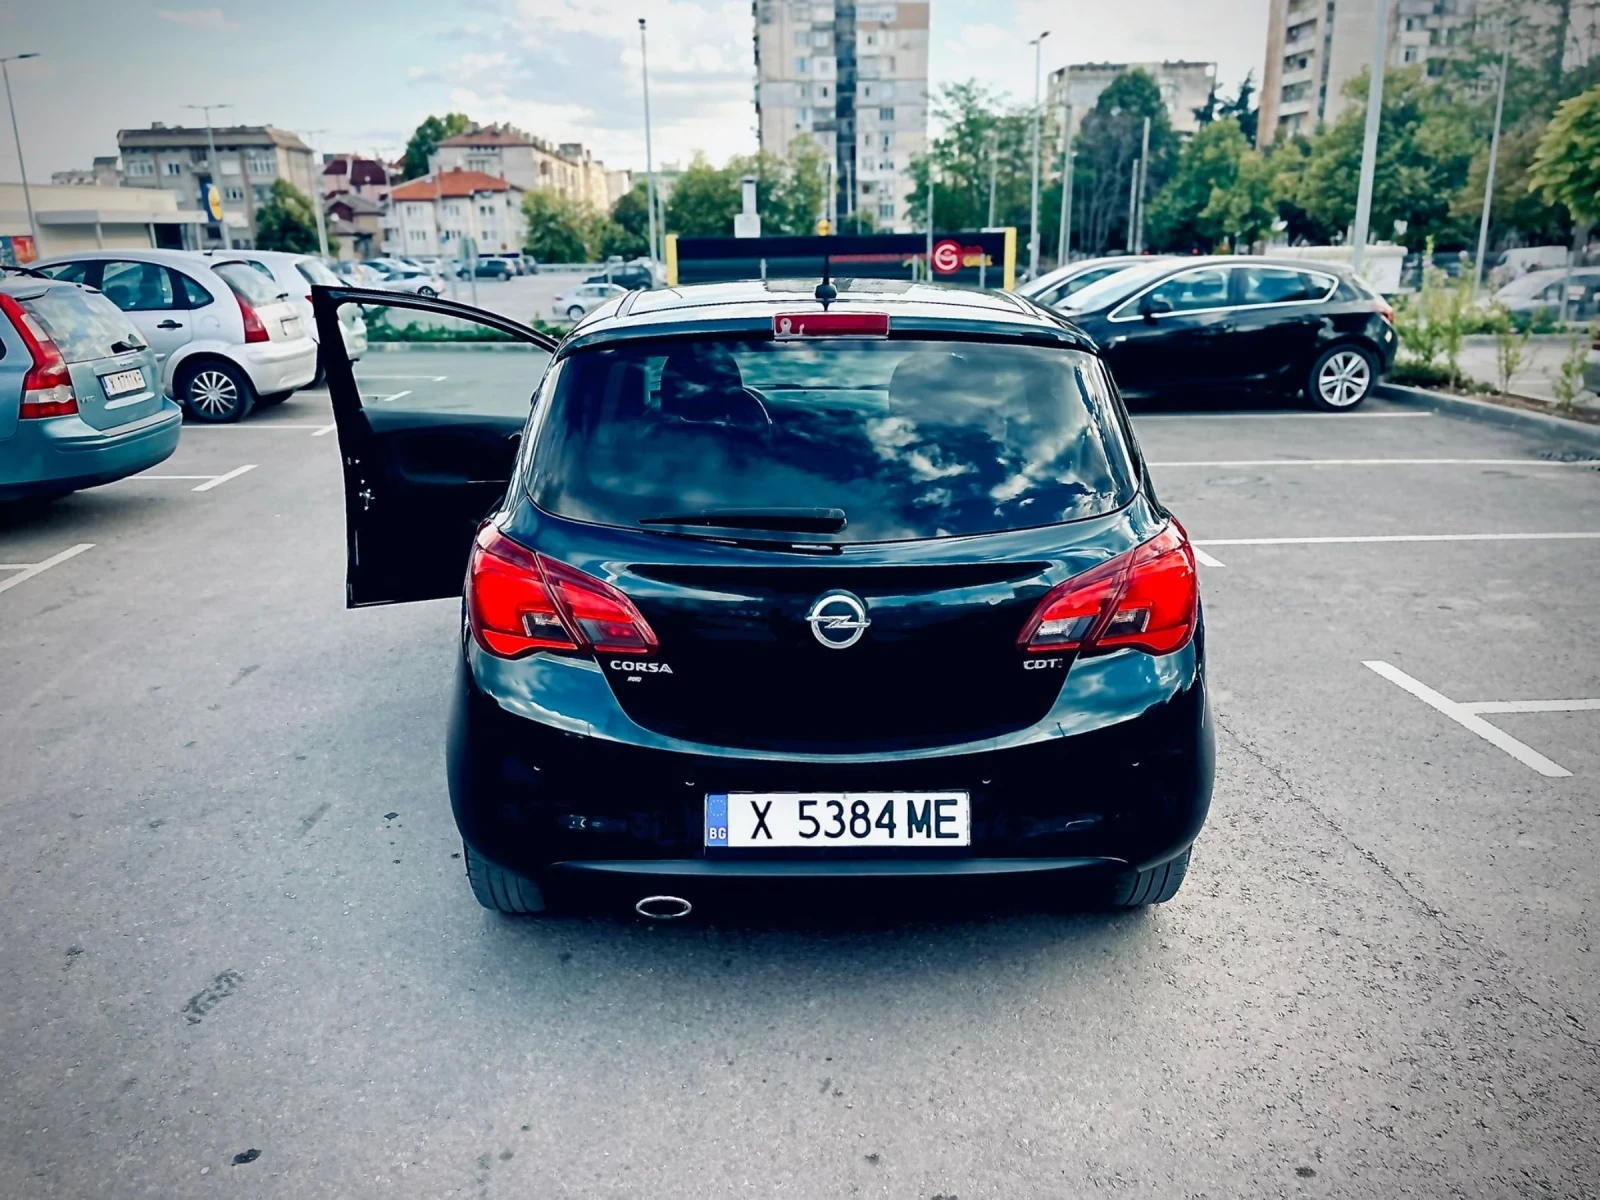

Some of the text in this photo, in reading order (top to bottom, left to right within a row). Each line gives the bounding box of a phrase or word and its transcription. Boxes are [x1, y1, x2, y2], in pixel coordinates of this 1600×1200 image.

[610, 660, 673, 674] CORSA
[750, 799, 960, 840] X 5384 ME
[709, 827, 726, 840] BG
